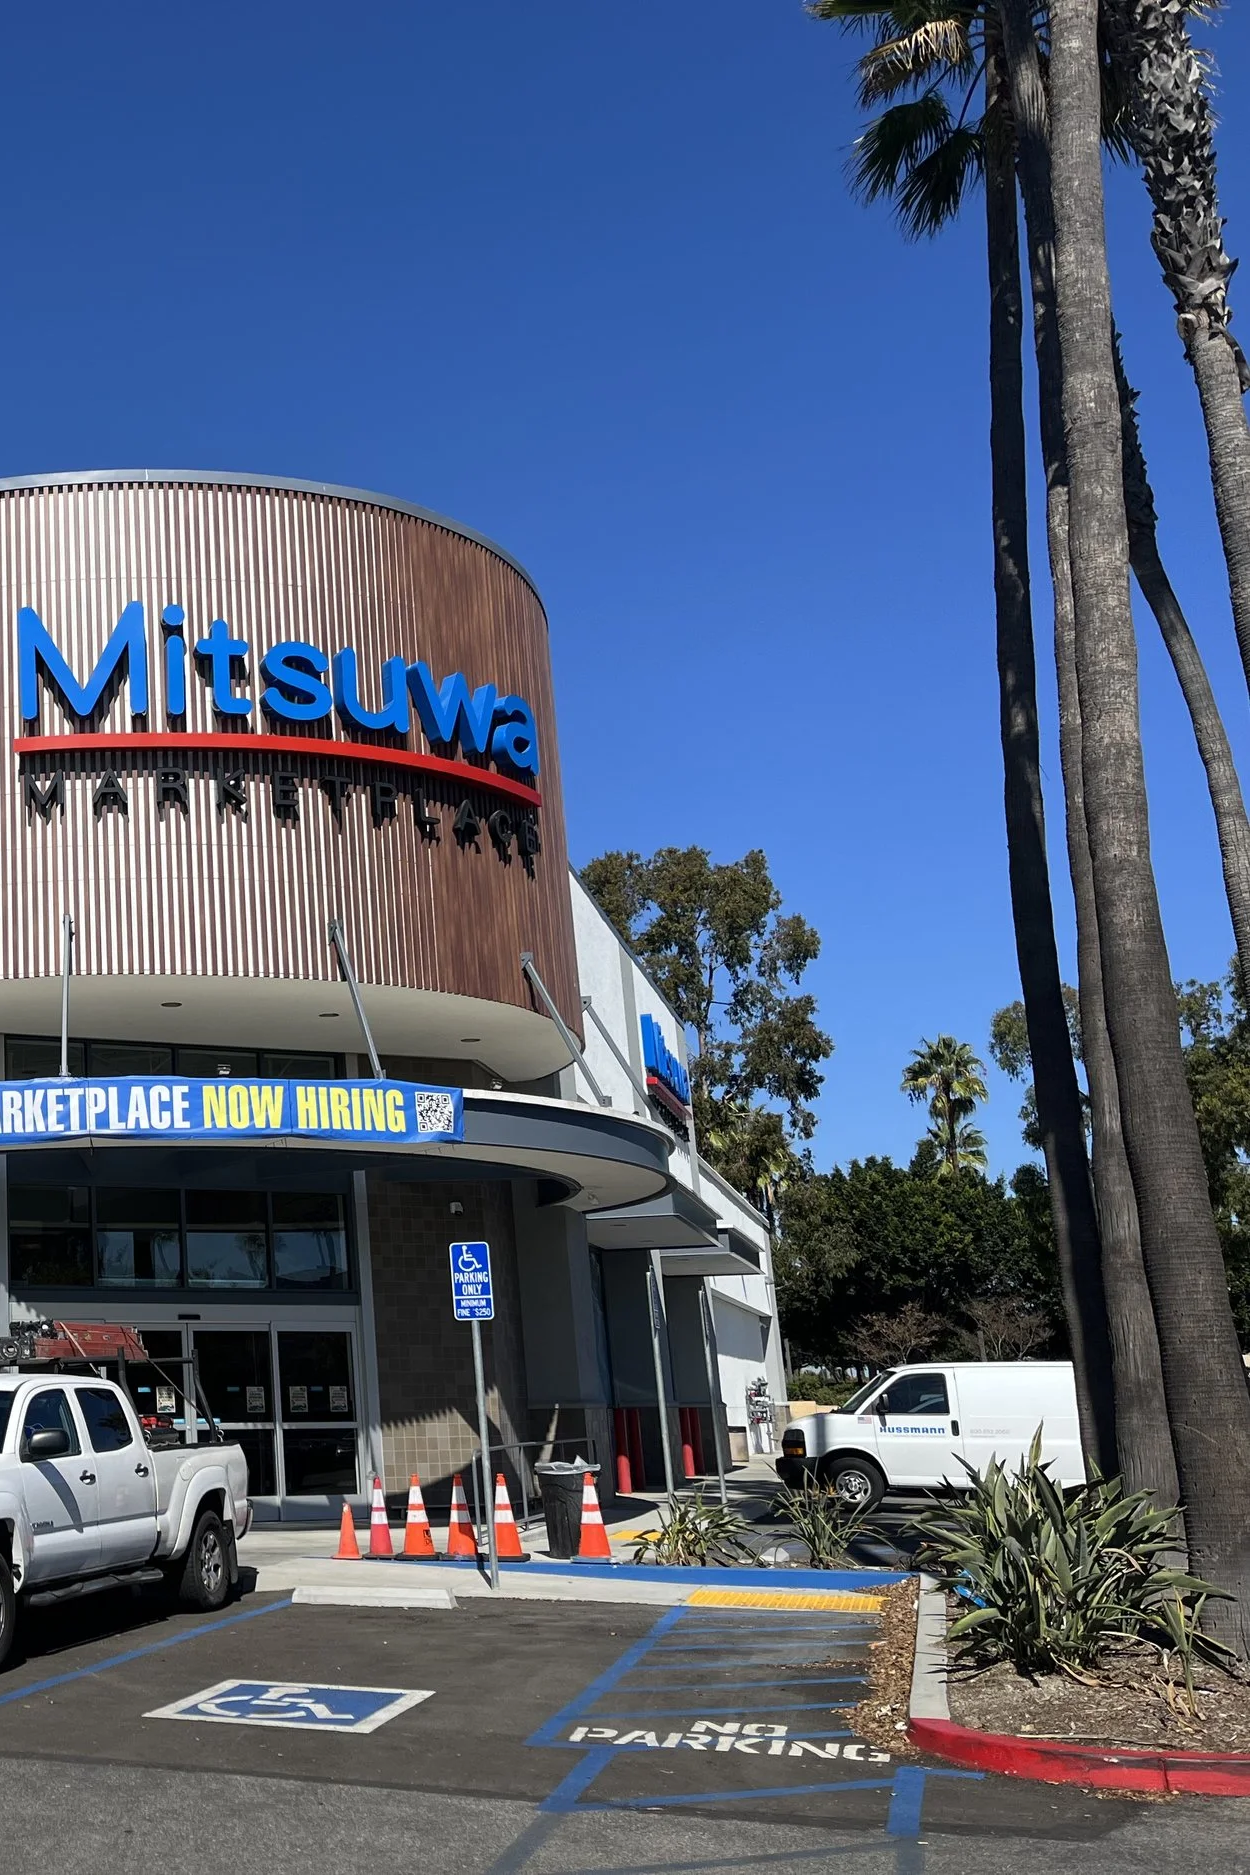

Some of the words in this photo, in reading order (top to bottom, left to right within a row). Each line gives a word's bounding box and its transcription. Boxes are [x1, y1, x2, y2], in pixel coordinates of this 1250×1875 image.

[18, 600, 540, 776] Mitsuwa
[22, 767, 541, 858] MARKETPLACE
[202, 1085, 284, 1129] NOW
[296, 1086, 406, 1132] HIRING
[454, 1272, 489, 1283] PARKING
[462, 1284, 482, 1295] ONLY
[460, 1299, 487, 1308] MINIMUM
[457, 1309, 471, 1317] FINE
[475, 1308, 491, 1317] $250
[690, 1720, 788, 1737] NO
[569, 1727, 891, 1763] PARKING
